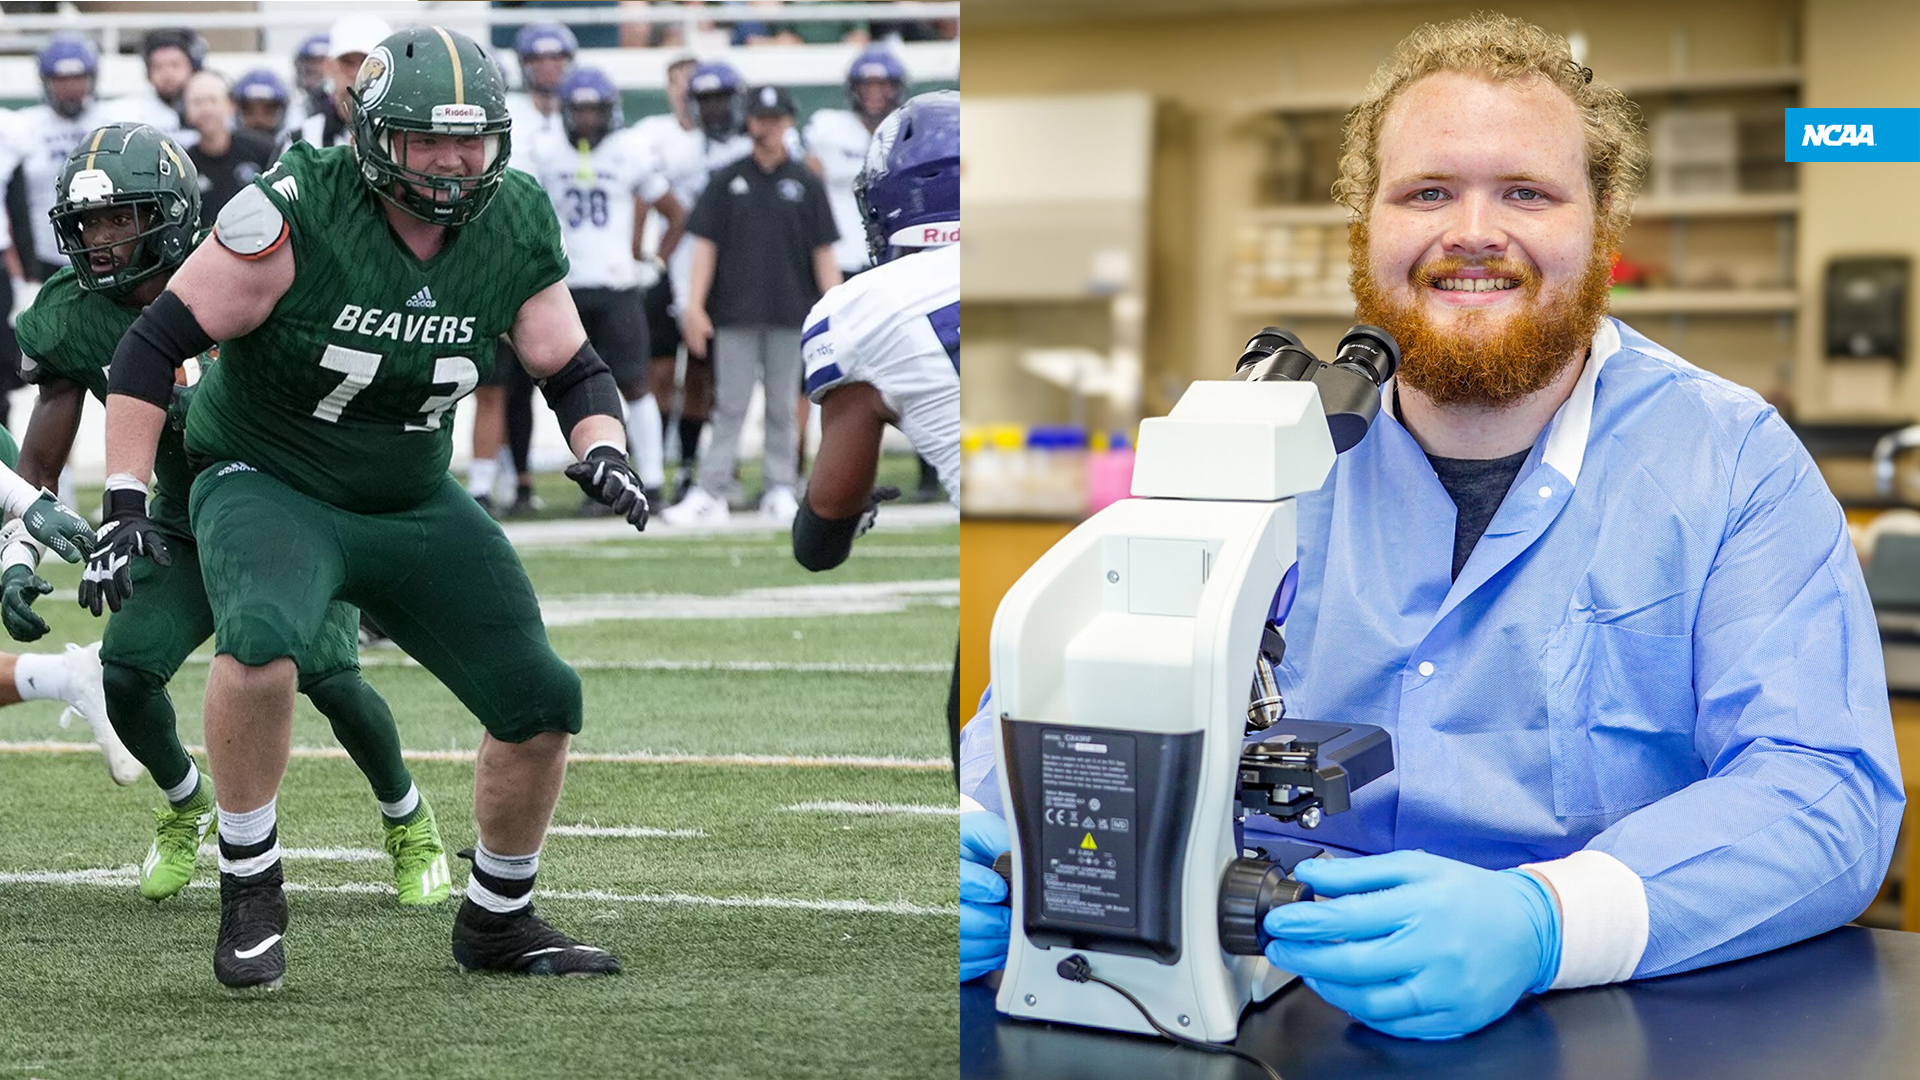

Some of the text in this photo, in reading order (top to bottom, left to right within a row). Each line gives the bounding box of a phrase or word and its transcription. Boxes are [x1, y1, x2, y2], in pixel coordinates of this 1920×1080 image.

[444, 107, 474, 116] Riddell
[564, 187, 610, 229] 38
[332, 304, 477, 344] BEAVERS
[405, 299, 438, 309] adidas
[312, 344, 479, 432] 73
